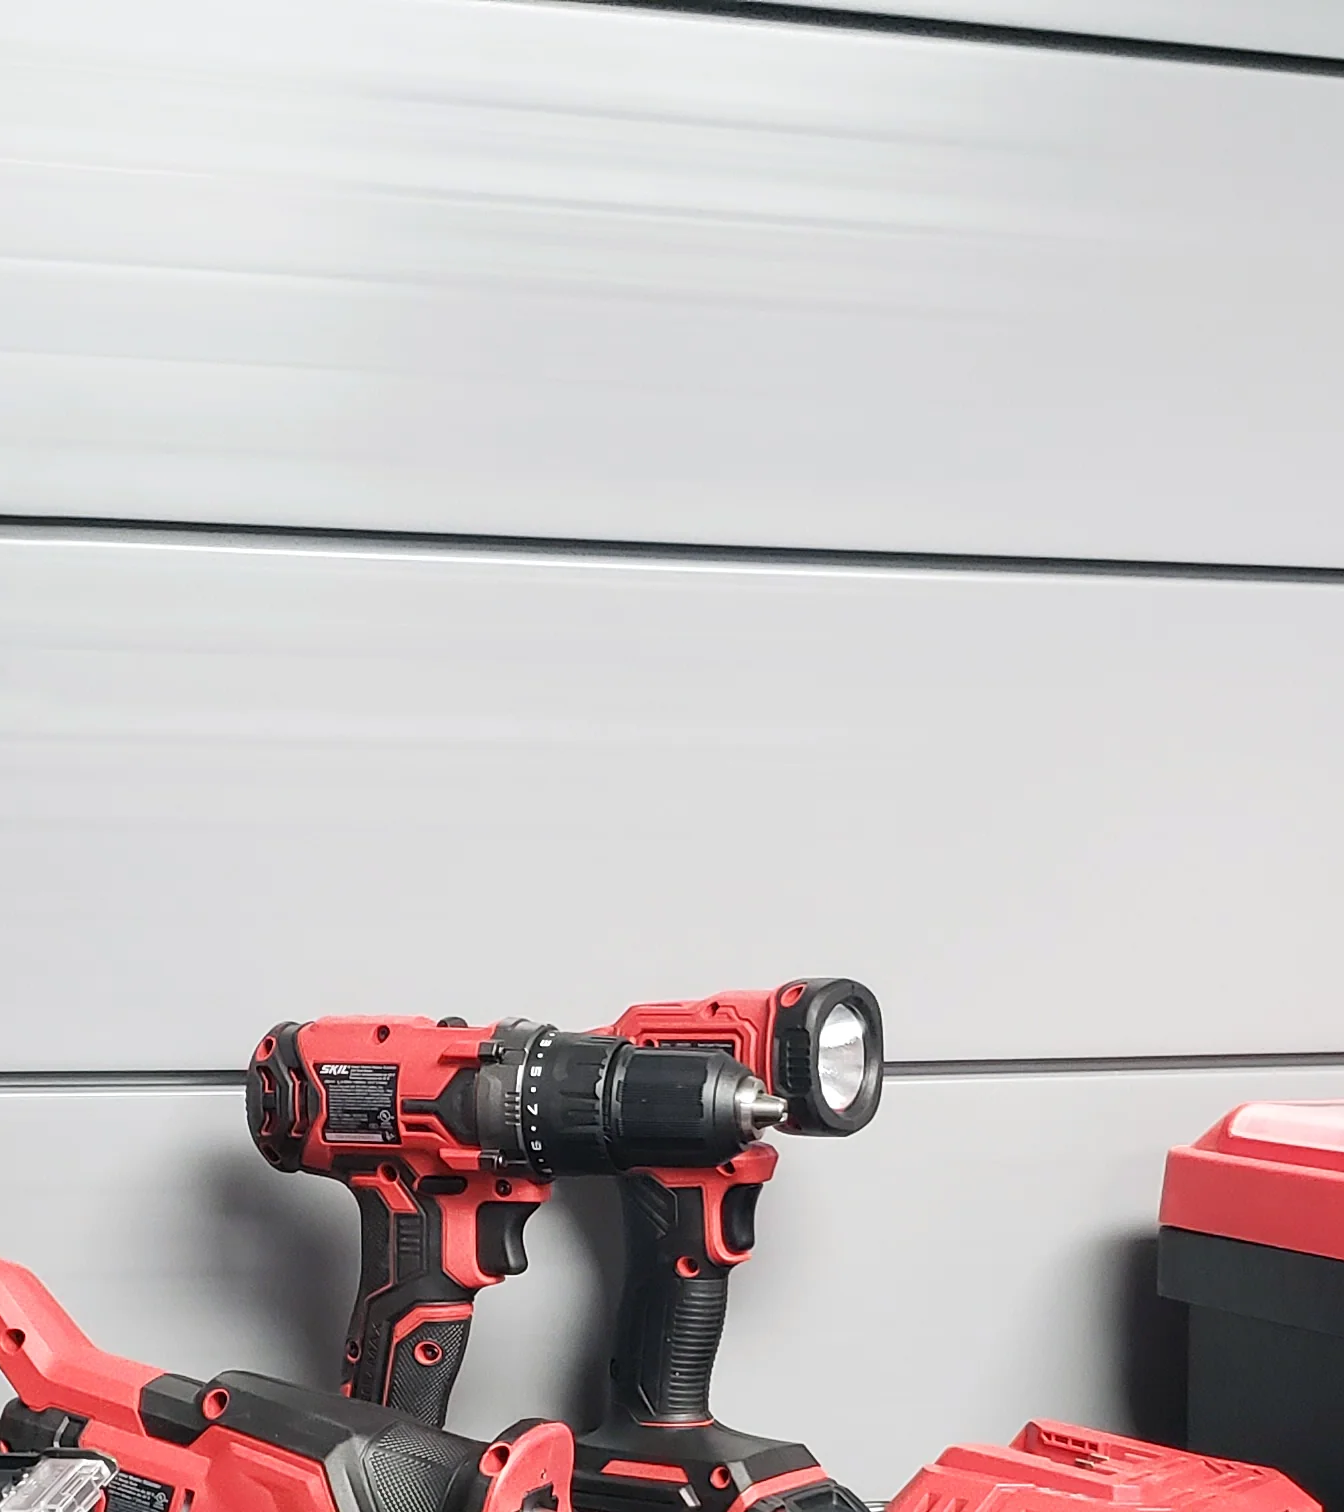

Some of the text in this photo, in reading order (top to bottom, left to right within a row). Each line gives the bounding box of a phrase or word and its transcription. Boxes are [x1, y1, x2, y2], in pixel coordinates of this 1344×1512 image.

[320, 1065, 349, 1075] SKIL
[530, 1066, 542, 1077] 5
[527, 1103, 538, 1116] 7
